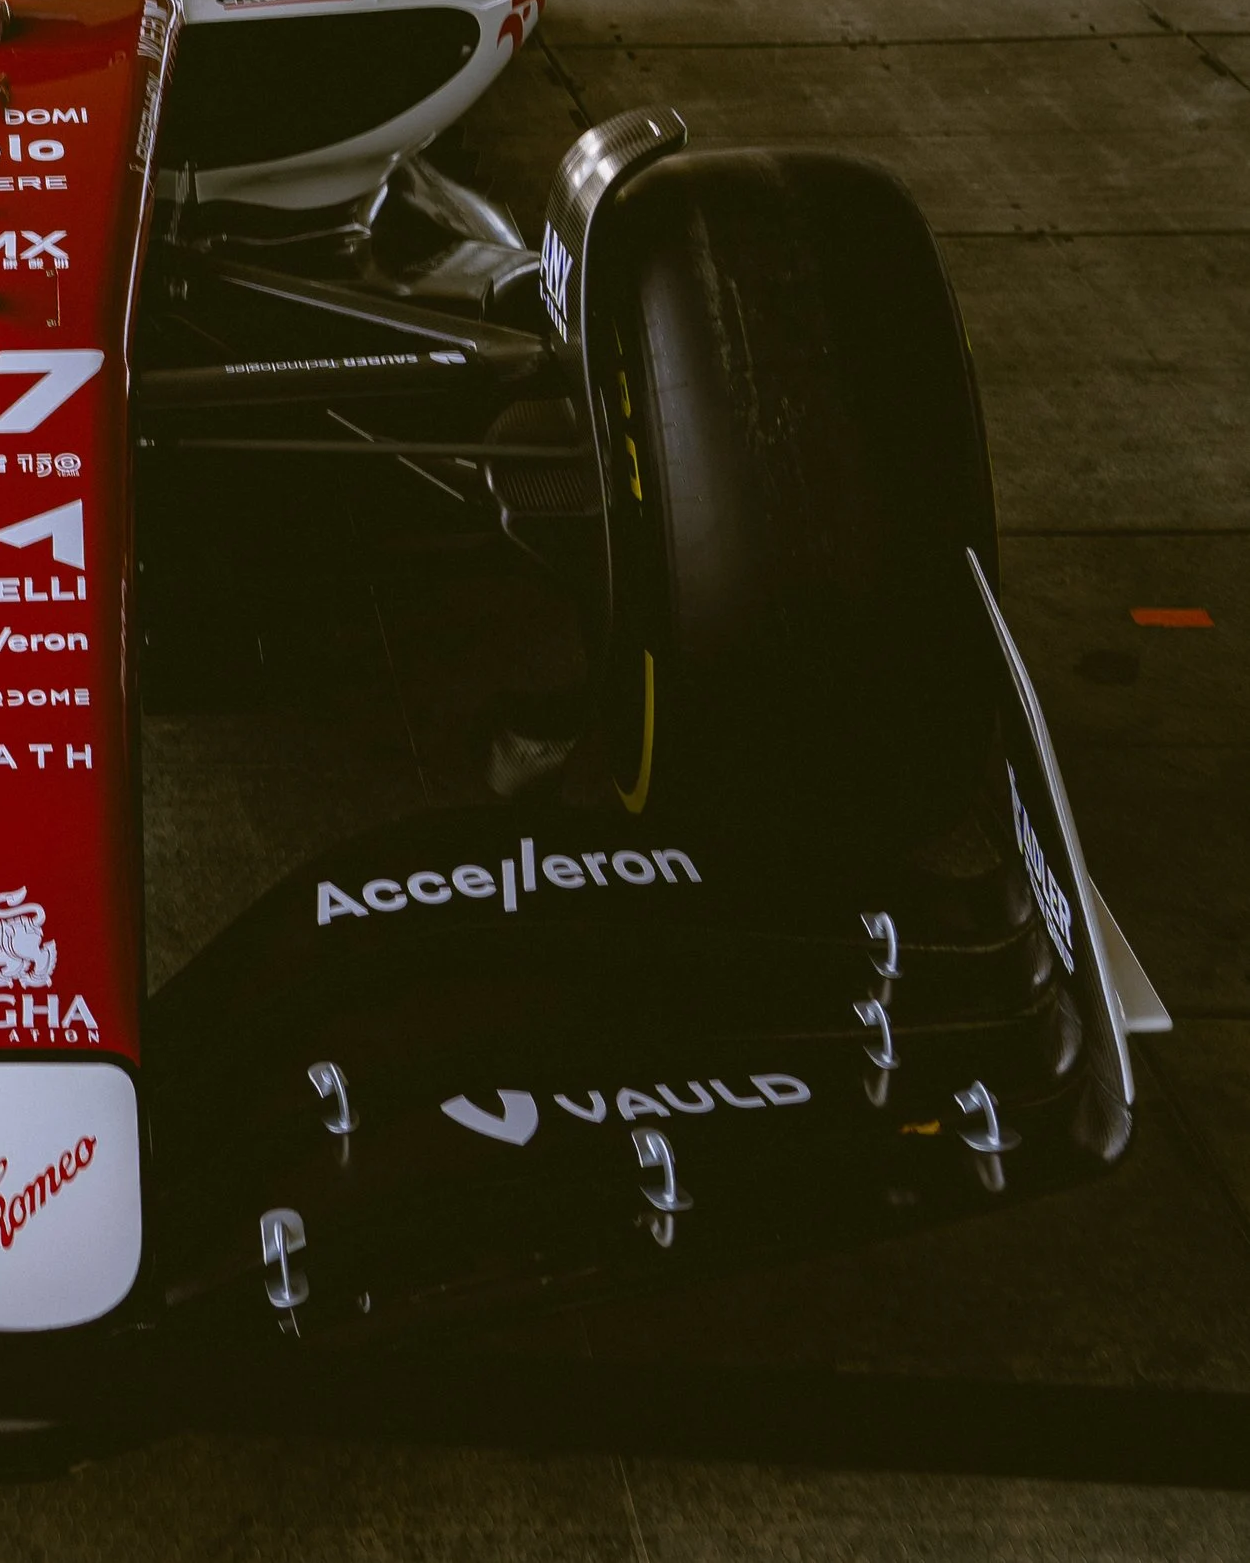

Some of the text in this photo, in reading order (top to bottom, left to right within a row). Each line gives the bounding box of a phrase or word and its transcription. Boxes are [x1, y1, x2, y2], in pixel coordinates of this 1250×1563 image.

[5, 107, 87, 125] DOMI
[225, 354, 418, 374] SAUBER Technologies
[553, 1072, 811, 1125] VAULD
